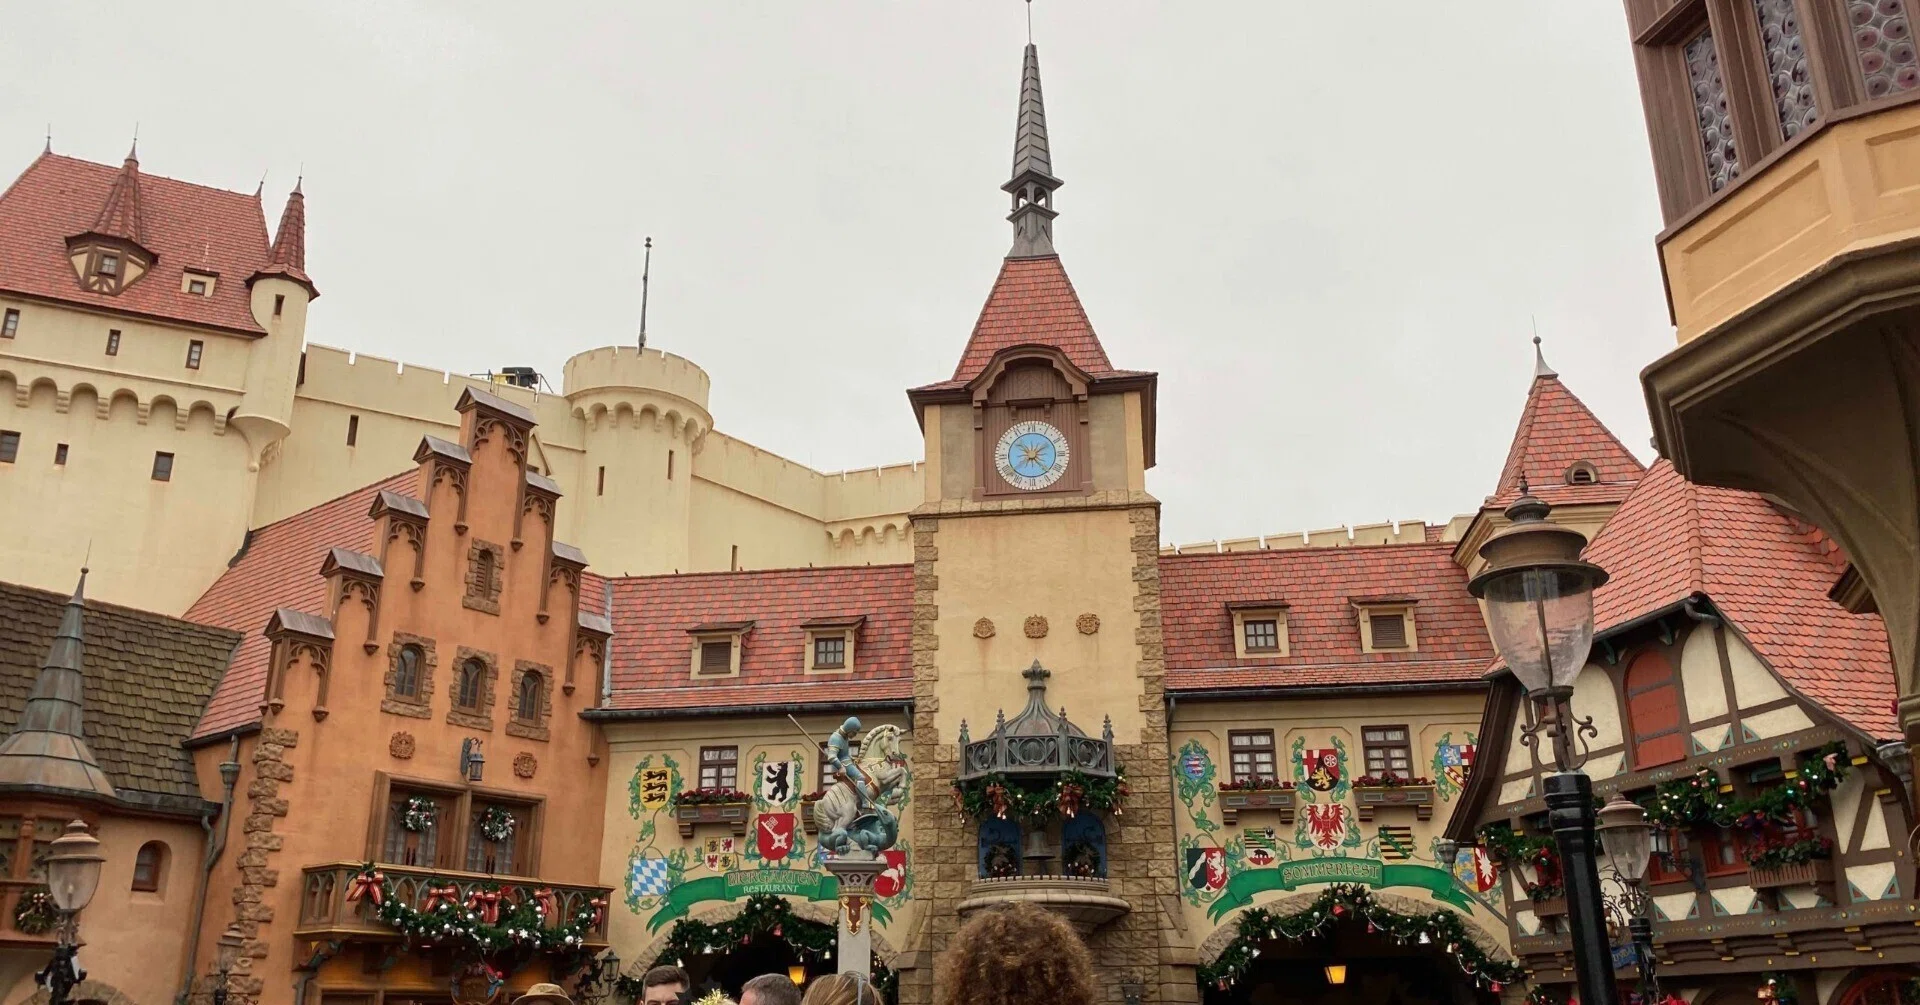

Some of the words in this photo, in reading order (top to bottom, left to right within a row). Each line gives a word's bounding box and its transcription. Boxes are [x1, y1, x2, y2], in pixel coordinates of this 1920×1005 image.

[728, 870, 819, 886] BIERGARTEN
[1284, 862, 1379, 882] SOMMERFEST
[743, 884, 799, 893] RESTAURANT
